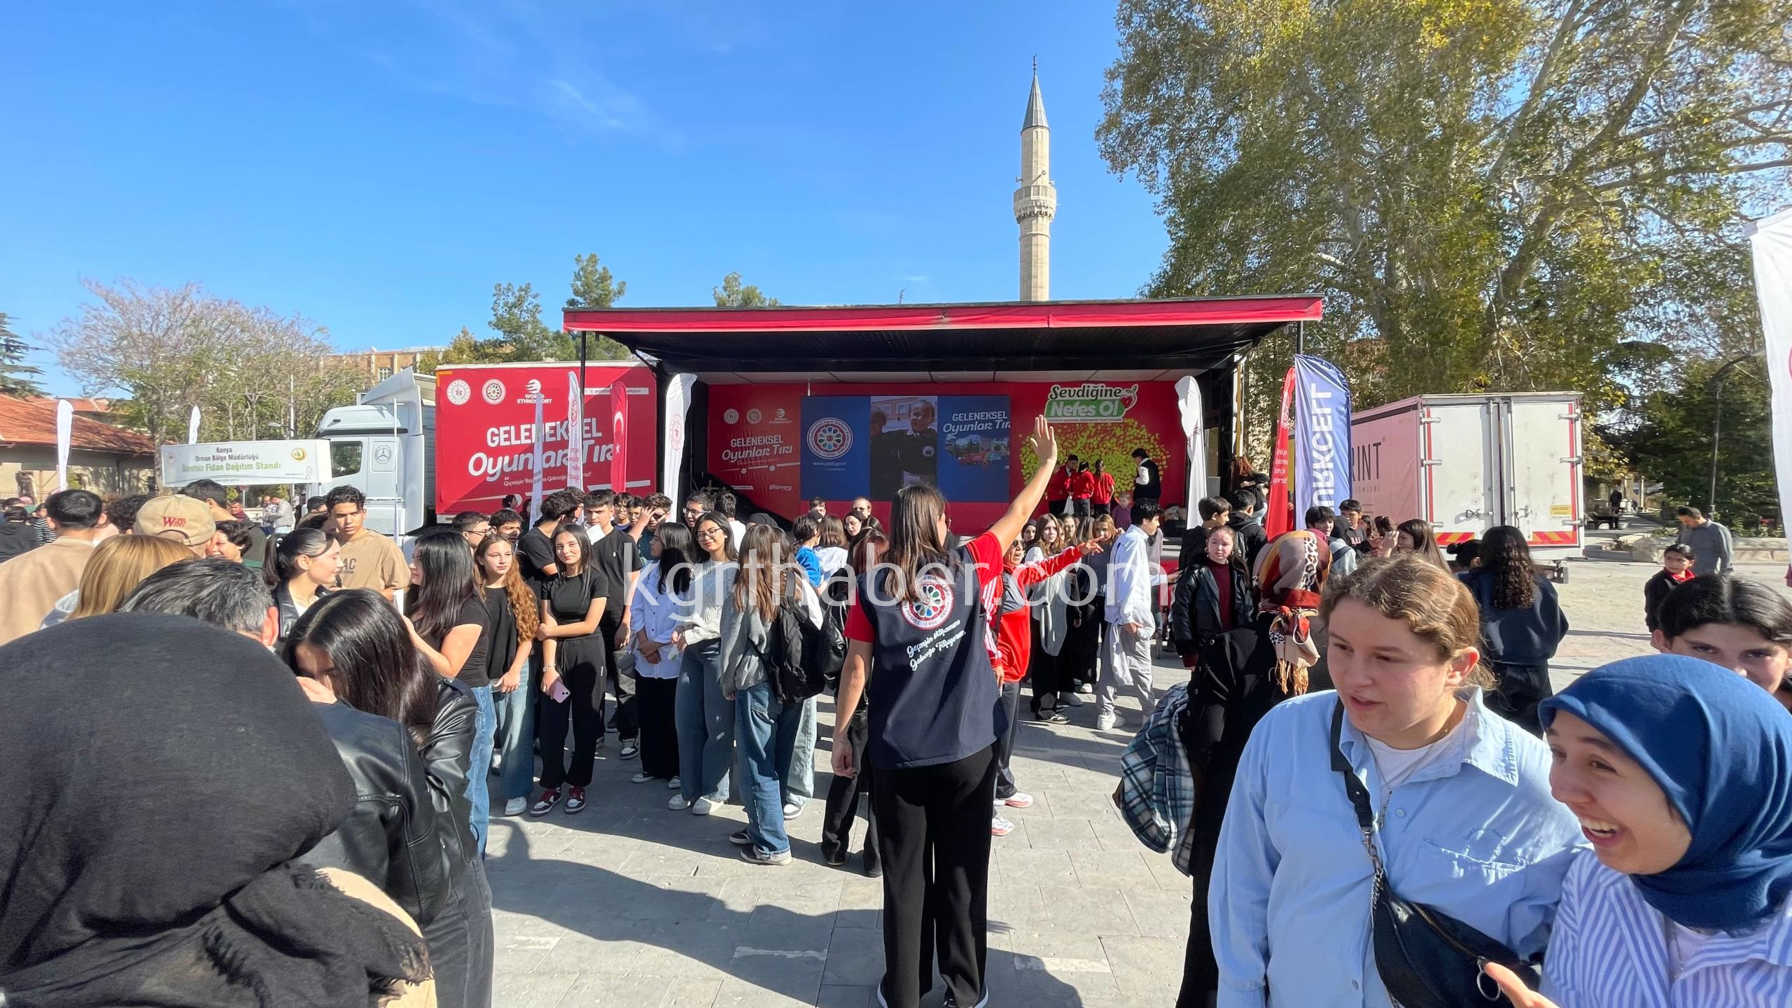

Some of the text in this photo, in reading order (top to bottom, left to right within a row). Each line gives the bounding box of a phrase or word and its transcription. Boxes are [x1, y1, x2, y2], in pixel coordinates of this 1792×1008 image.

[1049, 385, 1121, 401] Sevdiğine
[1051, 400, 1119, 417] Nefes Ol
[486, 417, 602, 447] GELEEKEL
[468, 449, 569, 482] Oyunar
